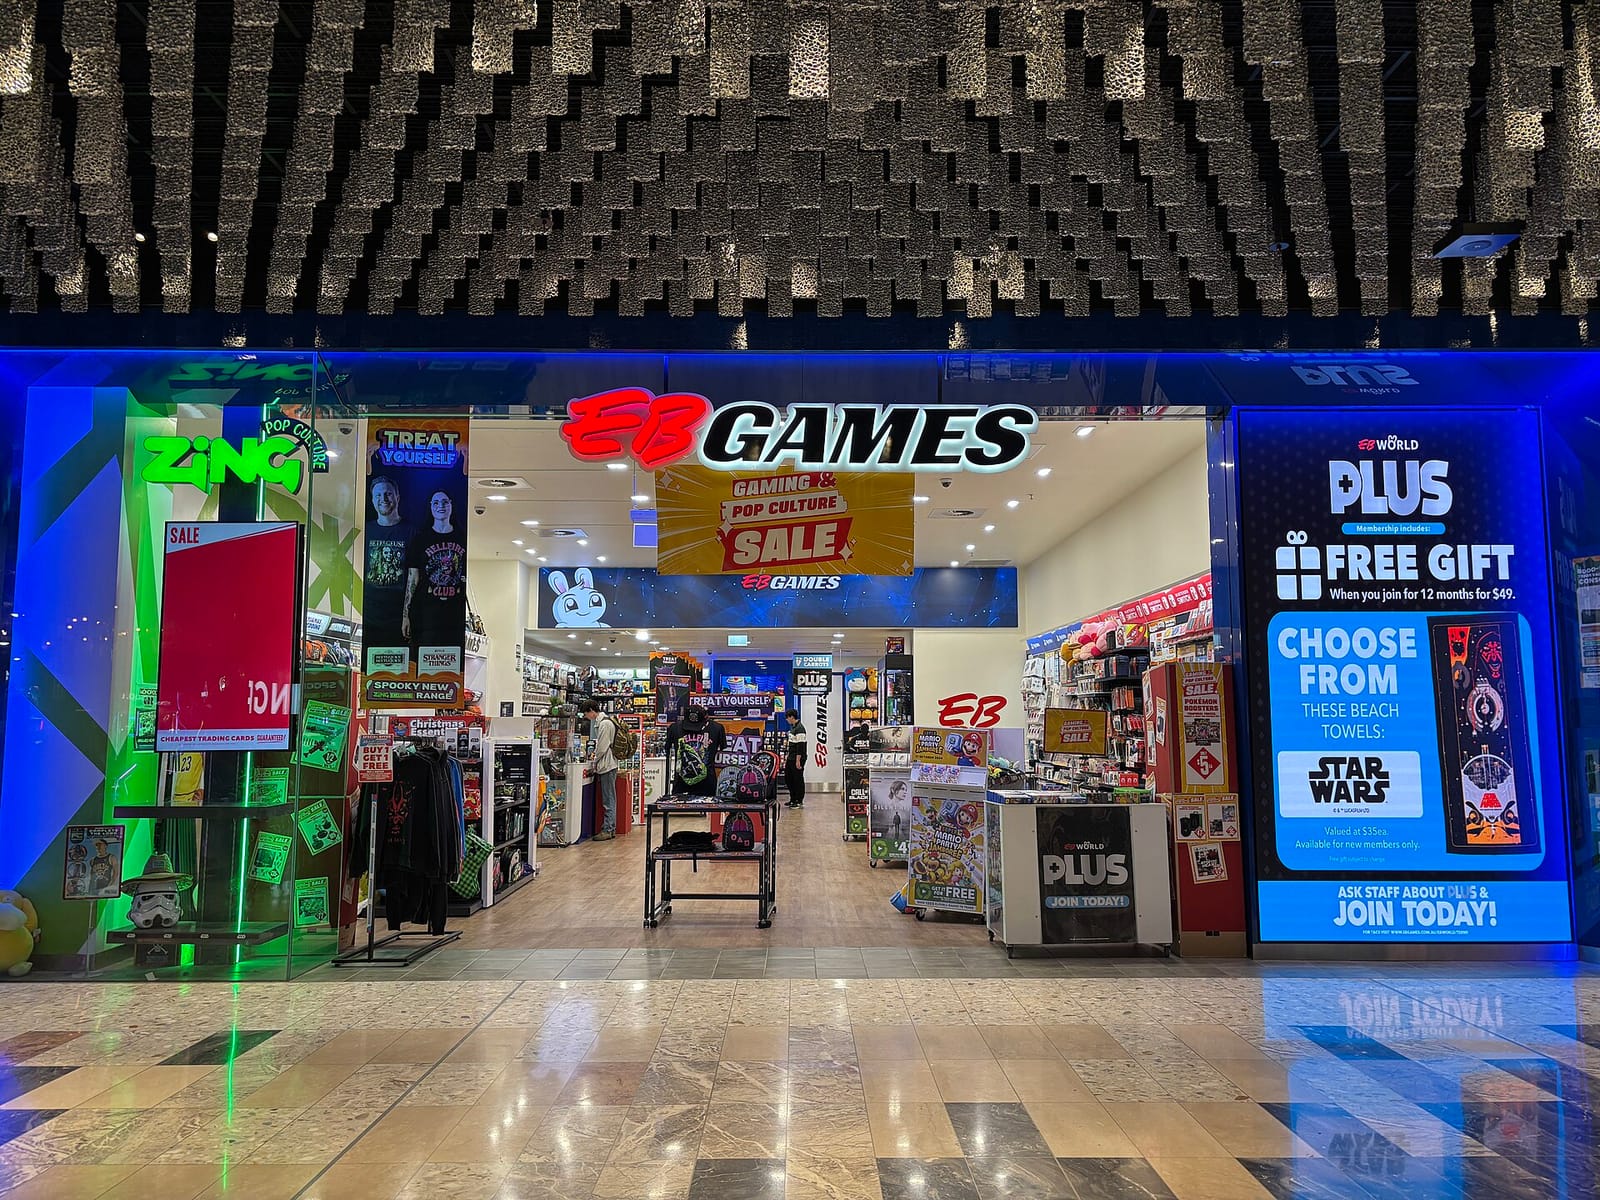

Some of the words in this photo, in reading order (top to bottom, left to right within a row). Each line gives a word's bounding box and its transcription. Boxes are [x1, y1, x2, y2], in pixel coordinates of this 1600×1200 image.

[265, 419, 291, 435] POP
[562, 388, 712, 469] EB
[700, 400, 1038, 469] GAMES
[384, 430, 459, 451] TREAT
[1358, 439, 1375, 450] EB
[1376, 435, 1418, 450] WORLD
[383, 450, 456, 465] YOURSELF
[732, 474, 811, 497] GAMING
[819, 471, 838, 489] &
[1328, 459, 1454, 517] PLUS
[732, 502, 765, 518] POP
[767, 494, 838, 515] CULTURE
[169, 526, 200, 544] SALE
[1356, 524, 1399, 534] Membership
[1400, 524, 1431, 533] includes:
[425, 541, 466, 557] HELLFIRE
[732, 522, 839, 565] SALE
[1326, 544, 1419, 581] FREE
[1427, 543, 1515, 581] GIFT
[741, 574, 771, 590] EB
[769, 575, 841, 590] GAMES
[433, 586, 456, 597] CLUB
[1330, 588, 1359, 601] When
[1360, 591, 1380, 602] you
[1381, 588, 1402, 602] join
[1403, 588, 1420, 600] for
[1420, 588, 1434, 600] 12
[1436, 588, 1474, 600] months
[1475, 588, 1492, 600] for
[1492, 588, 1516, 601] $49.
[1277, 627, 1418, 659] CHOOSE
[423, 654, 457, 662] STRANGER
[374, 681, 420, 690] SPOOKY
[422, 682, 449, 691] NEW
[797, 674, 828, 686] PLUS
[1300, 664, 1398, 695] FROM
[416, 692, 454, 700] RANGE
[1186, 683, 1215, 696] SALE
[690, 696, 722, 706] TREAT
[724, 696, 770, 705] YOURSELF
[938, 692, 1008, 728] EB
[1302, 702, 1346, 718] THESE
[1350, 702, 1400, 718] BEACH
[410, 719, 464, 729] Christmas
[1321, 724, 1385, 739] TOWELS:
[722, 735, 762, 754] EAT
[1063, 732, 1090, 742] SALE
[815, 742, 828, 768] EB
[180, 756, 192, 772] 23
[1308, 756, 1390, 780] STAR
[1308, 780, 1390, 804] WARS
[934, 830, 962, 844] MARIO
[1324, 826, 1351, 836] Valued
[1352, 828, 1361, 836] at
[1362, 826, 1390, 836] $35ea.
[936, 838, 959, 850] PARTY
[1076, 841, 1105, 850] WORLD
[1295, 840, 1331, 849] Available
[1332, 839, 1344, 849] for
[1346, 841, 1362, 849] new
[1364, 840, 1400, 849] members
[1402, 840, 1421, 851] only.
[1042, 854, 1129, 886] PLUS
[946, 886, 976, 900] FREE
[1338, 886, 1362, 898] ASK
[1365, 886, 1400, 898] STAFF
[1402, 886, 1444, 898] ABOUT
[1448, 886, 1476, 899] PLUS
[1480, 887, 1489, 898] &
[1052, 896, 1079, 907] JOIN
[1082, 896, 1124, 907] TODAY!
[1333, 900, 1394, 926] JOIN
[1402, 900, 1498, 927] TODAY!
